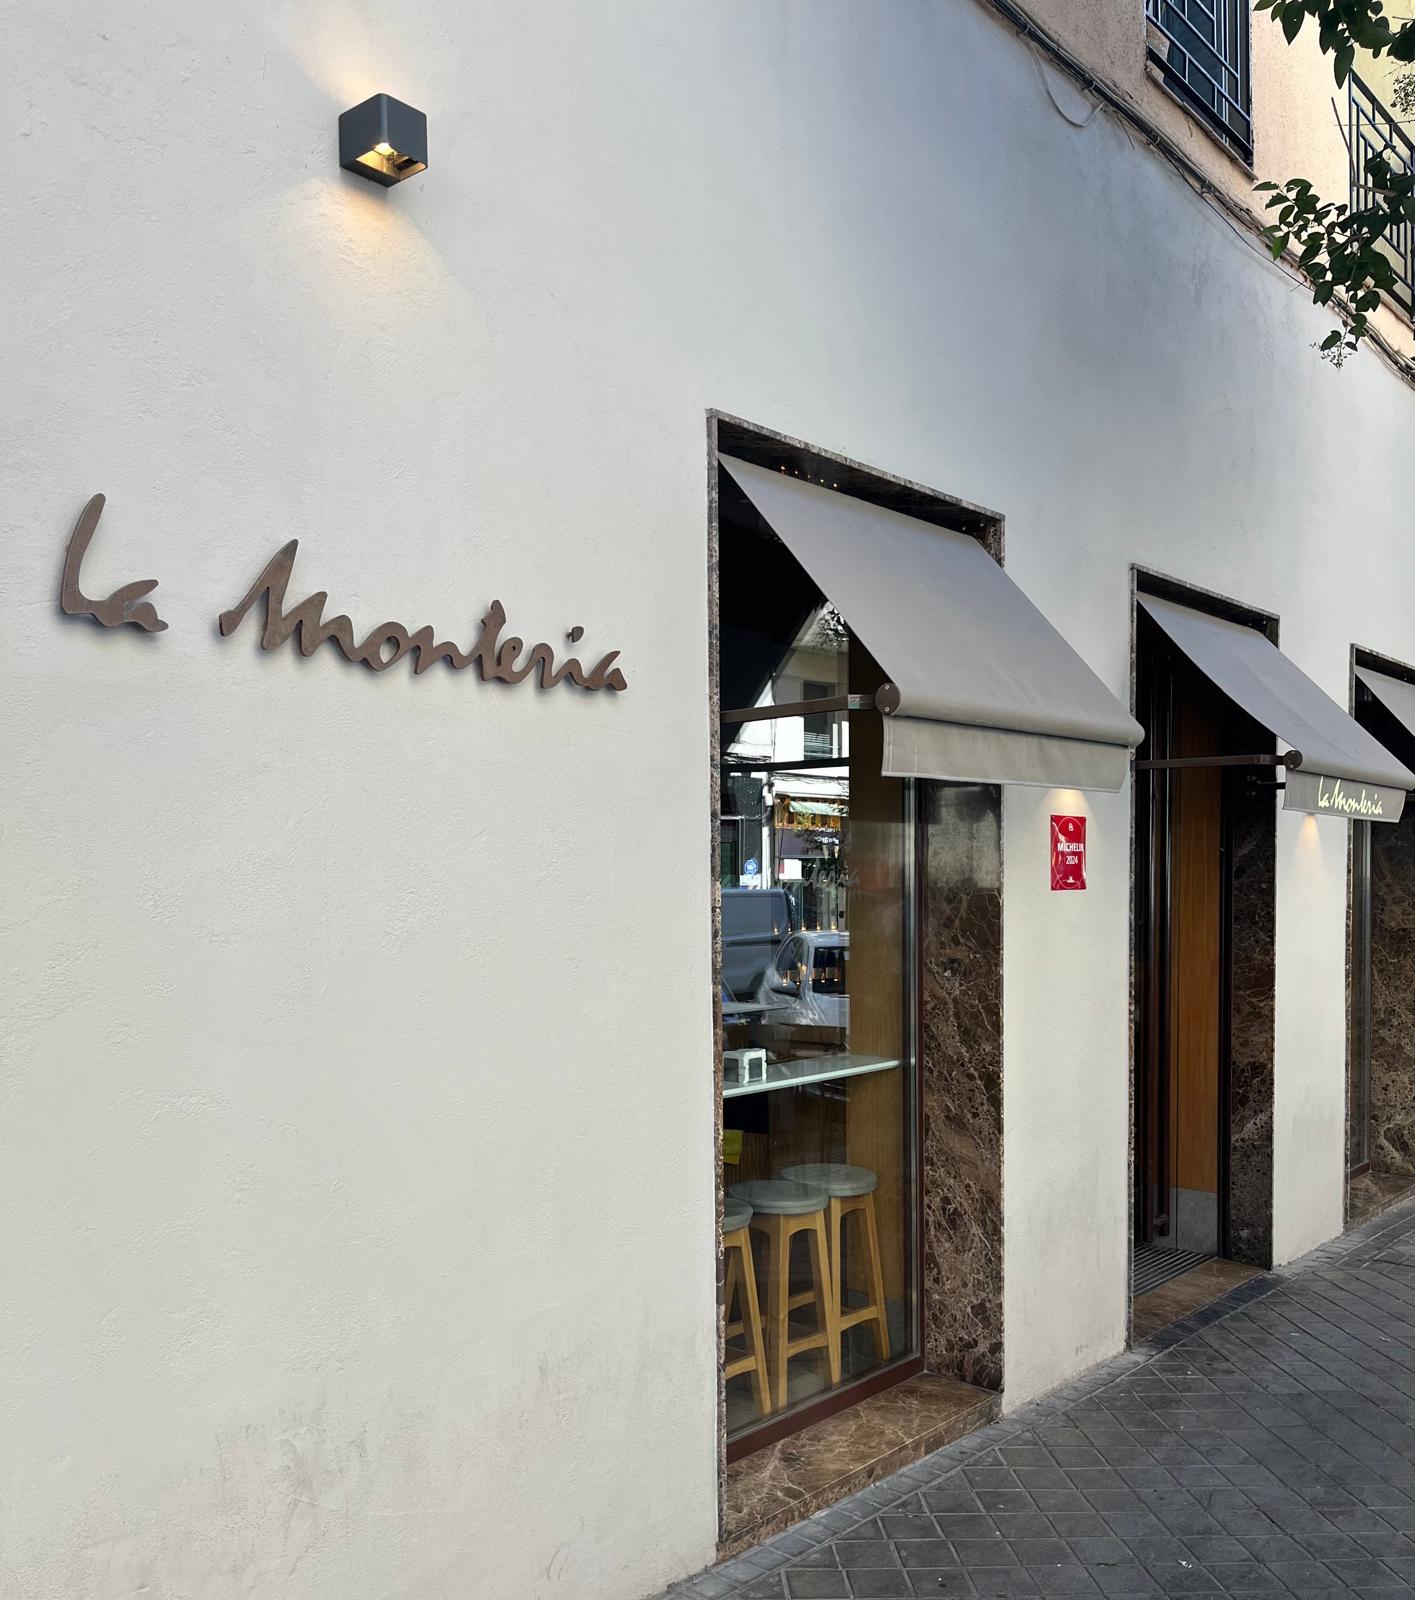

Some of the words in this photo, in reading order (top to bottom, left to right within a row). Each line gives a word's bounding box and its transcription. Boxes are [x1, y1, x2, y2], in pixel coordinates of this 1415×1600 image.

[61, 492, 169, 632] La
[1318, 775, 1330, 808] La
[1057, 842, 1084, 852] MICHELIN
[1065, 855, 1079, 865] 2024
